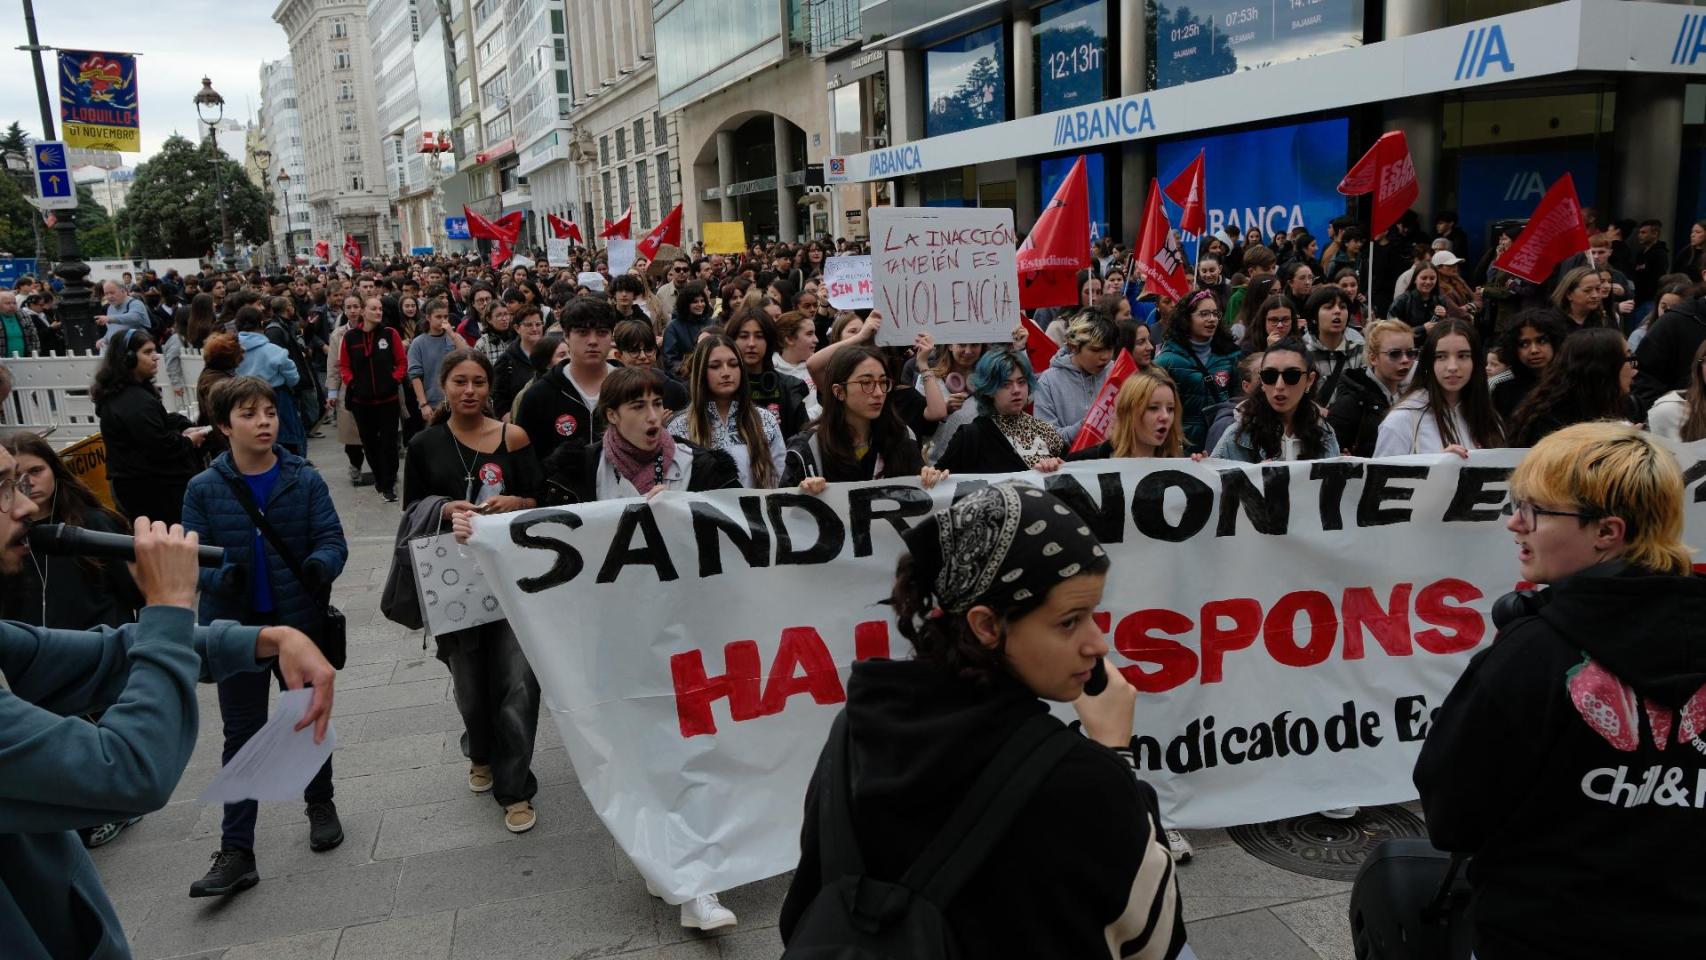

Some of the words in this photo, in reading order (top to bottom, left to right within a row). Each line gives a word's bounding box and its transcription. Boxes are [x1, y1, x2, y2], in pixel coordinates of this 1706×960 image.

[1226, 7, 1258, 27] 07:53h
[1291, 14, 1322, 30] BAJAMAR
[1171, 23, 1199, 42] 01:25h
[1048, 42, 1099, 80] 12:13h
[72, 107, 131, 124] LOQUILLO
[84, 127, 134, 140] NOVEMBRO
[884, 225, 920, 252] LA
[925, 223, 1017, 248] INACCIÓN
[972, 252, 1000, 269] ES
[1020, 254, 1080, 270] Estudiantes
[831, 282, 853, 298] SIN
[509, 480, 985, 594] SANDR
[1044, 465, 1291, 543] NON
[1310, 462, 1429, 531] TE
[1324, 700, 1384, 752] de
